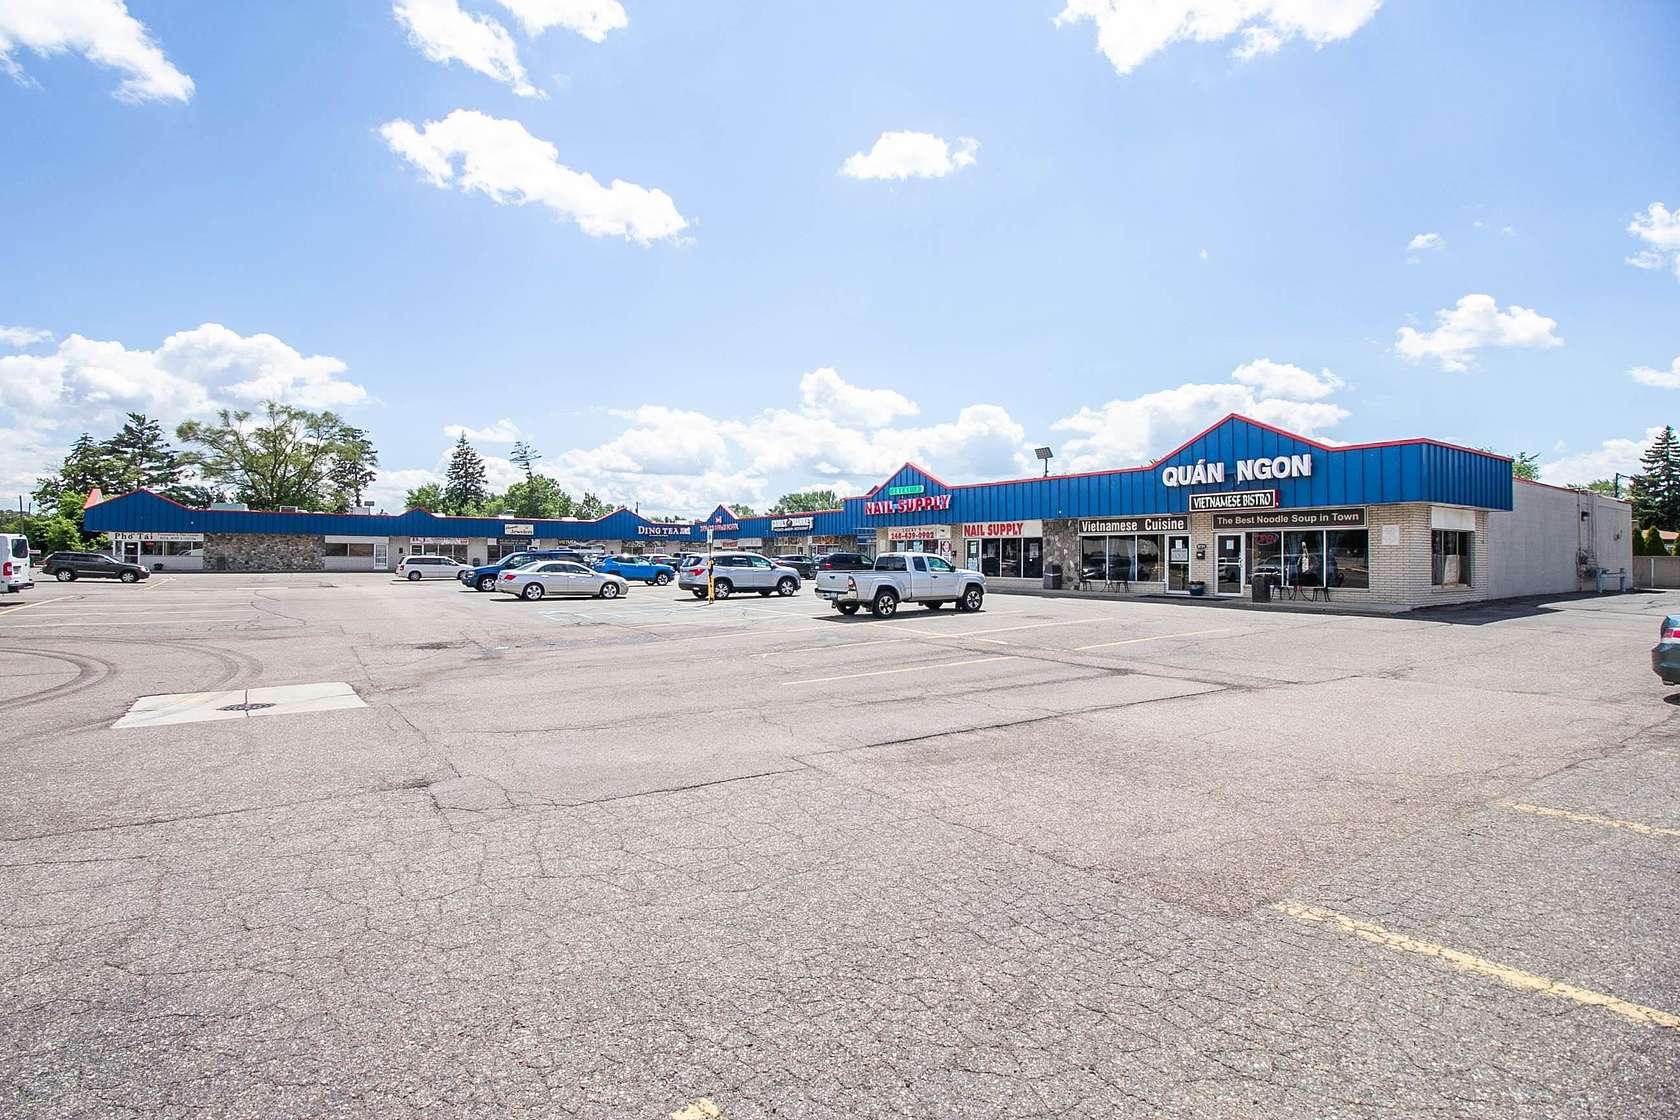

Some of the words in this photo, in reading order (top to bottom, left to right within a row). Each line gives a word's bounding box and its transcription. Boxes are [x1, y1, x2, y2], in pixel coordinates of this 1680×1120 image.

[1162, 459, 1225, 488] QUÁN
[1237, 454, 1312, 484] NGON
[864, 500, 896, 515] NAIL
[898, 495, 952, 513] SUPPLY
[1193, 494, 1242, 509] VIETNAMESE
[1243, 493, 1271, 507] BISTRO
[1082, 520, 1138, 532] Vietnamese
[1144, 518, 1184, 530] Cuisine
[1217, 517, 1233, 525] The
[1235, 514, 1255, 524] Best
[1256, 513, 1289, 523] Noodle
[1291, 513, 1317, 524] Soup
[1319, 511, 1329, 521] in
[1331, 512, 1359, 521] Town
[638, 526, 661, 534] DING
[964, 525, 985, 536] NAIL
[987, 522, 1024, 535] SUPPLY
